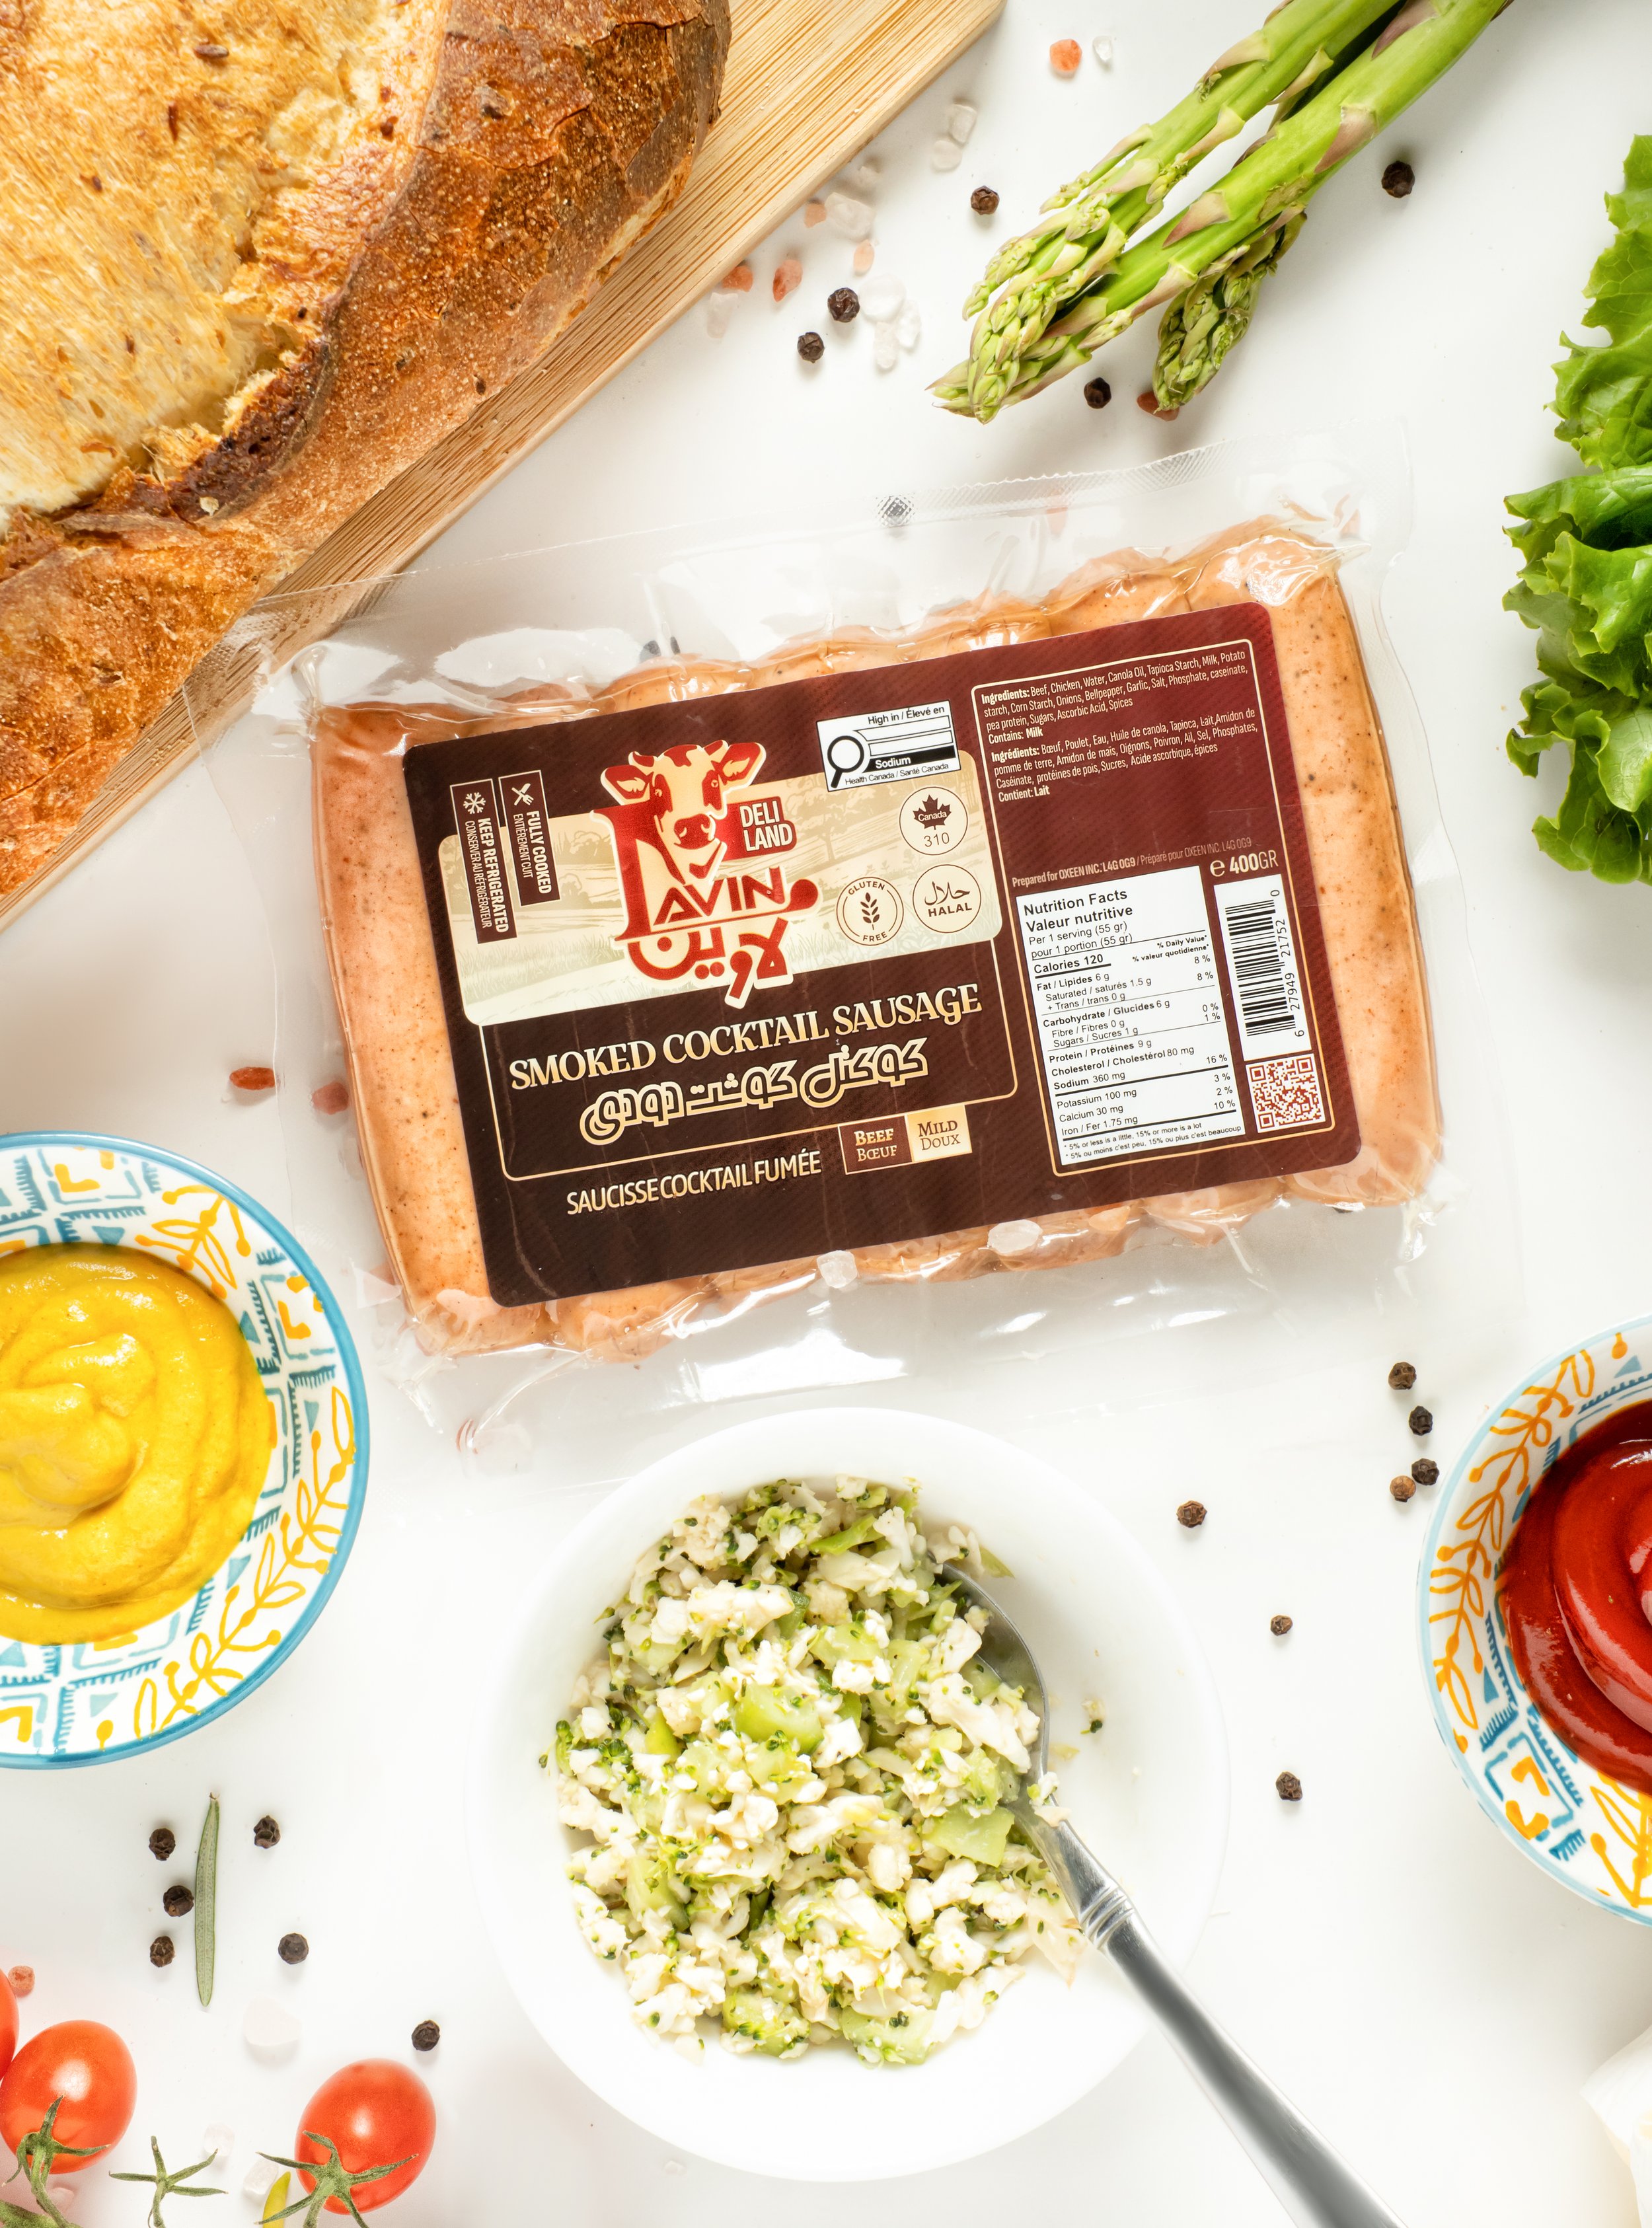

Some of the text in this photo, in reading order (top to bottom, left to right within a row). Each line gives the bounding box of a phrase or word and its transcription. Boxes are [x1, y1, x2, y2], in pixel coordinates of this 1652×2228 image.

[981, 650, 1246, 706] Ingredients: Beef, Chicken, Water, Canola Oil, Tapioca Starch, Milk, Potato
[983, 663, 1248, 718] starch, Corn Starch, Onions, Bellpepper, Garlic, Salt, Phosphate, caseinate,
[867, 706, 945, 726] High in Élevé en
[985, 697, 1133, 733] pea protein, Sugars, Ascorbic Acid, Spices
[987, 725, 1044, 745] Contains: Milk
[991, 746, 1040, 764] Ingrédients:
[1040, 740, 1064, 755] Bœuf,
[1064, 737, 1092, 751] Poulet,
[1092, 734, 1109, 745] Eau,
[1109, 729, 1129, 742] Huile
[1130, 726, 1141, 738] de
[1142, 722, 1169, 736] canola,
[1168, 719, 1199, 733] Tapioca,
[1245, 707, 1256, 719] de
[874, 757, 911, 769] Sodium
[993, 722, 1258, 778] pomme de terre, Amidon de maïs, Oignons, Poivron, Ail, Sel, Phosphates,
[845, 762, 949, 785] Health Canada Santé Canada
[995, 743, 1219, 789] Caséinate, protéines de pois, Sucres, Acide ascorbique, épices
[998, 784, 1051, 803] Contient: Lait
[739, 799, 780, 828] DELI
[917, 809, 949, 823] Canada
[512, 813, 534, 878] ENTIÈREMENT CUIT
[743, 820, 793, 852] LAND
[923, 831, 950, 848] 310
[525, 809, 552, 894] FULLY COOKED
[1228, 849, 1279, 874] 400GR
[464, 820, 492, 928] CONSERVER AU RÉFRIGÉRATEUR
[477, 817, 509, 933] KEEP REFRIGERATED
[1011, 871, 1047, 888] Prepared
[1045, 870, 1058, 882] for
[1058, 865, 1085, 879] OXEEN
[1084, 862, 1103, 875] INC.
[1101, 859, 1119, 872] L4G
[847, 880, 885, 895] GLUTEN
[923, 880, 971, 906] حلال
[927, 902, 973, 918] HALAL
[1023, 889, 1127, 916] Nutrition Facts
[1025, 906, 1133, 932] Valeur nutritive
[862, 930, 888, 942] FREE
[1028, 920, 1127, 946] Per 1 serving (55 gr)
[1165, 939, 1183, 947] Daily
[1033, 953, 1104, 974] Calories 120
[1140, 952, 1163, 961] valeur
[1269, 889, 1305, 1037] 6 27949 21752 0
[1036, 973, 1109, 991] Fat Lipides 6 g
[1042, 999, 1170, 1027] Carbohydrate Glucides 6 g
[509, 983, 983, 1090] SMOKED COCKTAIL SAUSAGE
[1048, 1039, 1152, 1063] Protein Protéines 9 g
[1051, 1047, 1195, 1077] Cholesterol Cholestérol 80 mg
[1053, 1072, 1125, 1090] Sodium 360 mg
[1056, 1089, 1137, 1109] Potassium 100 mg
